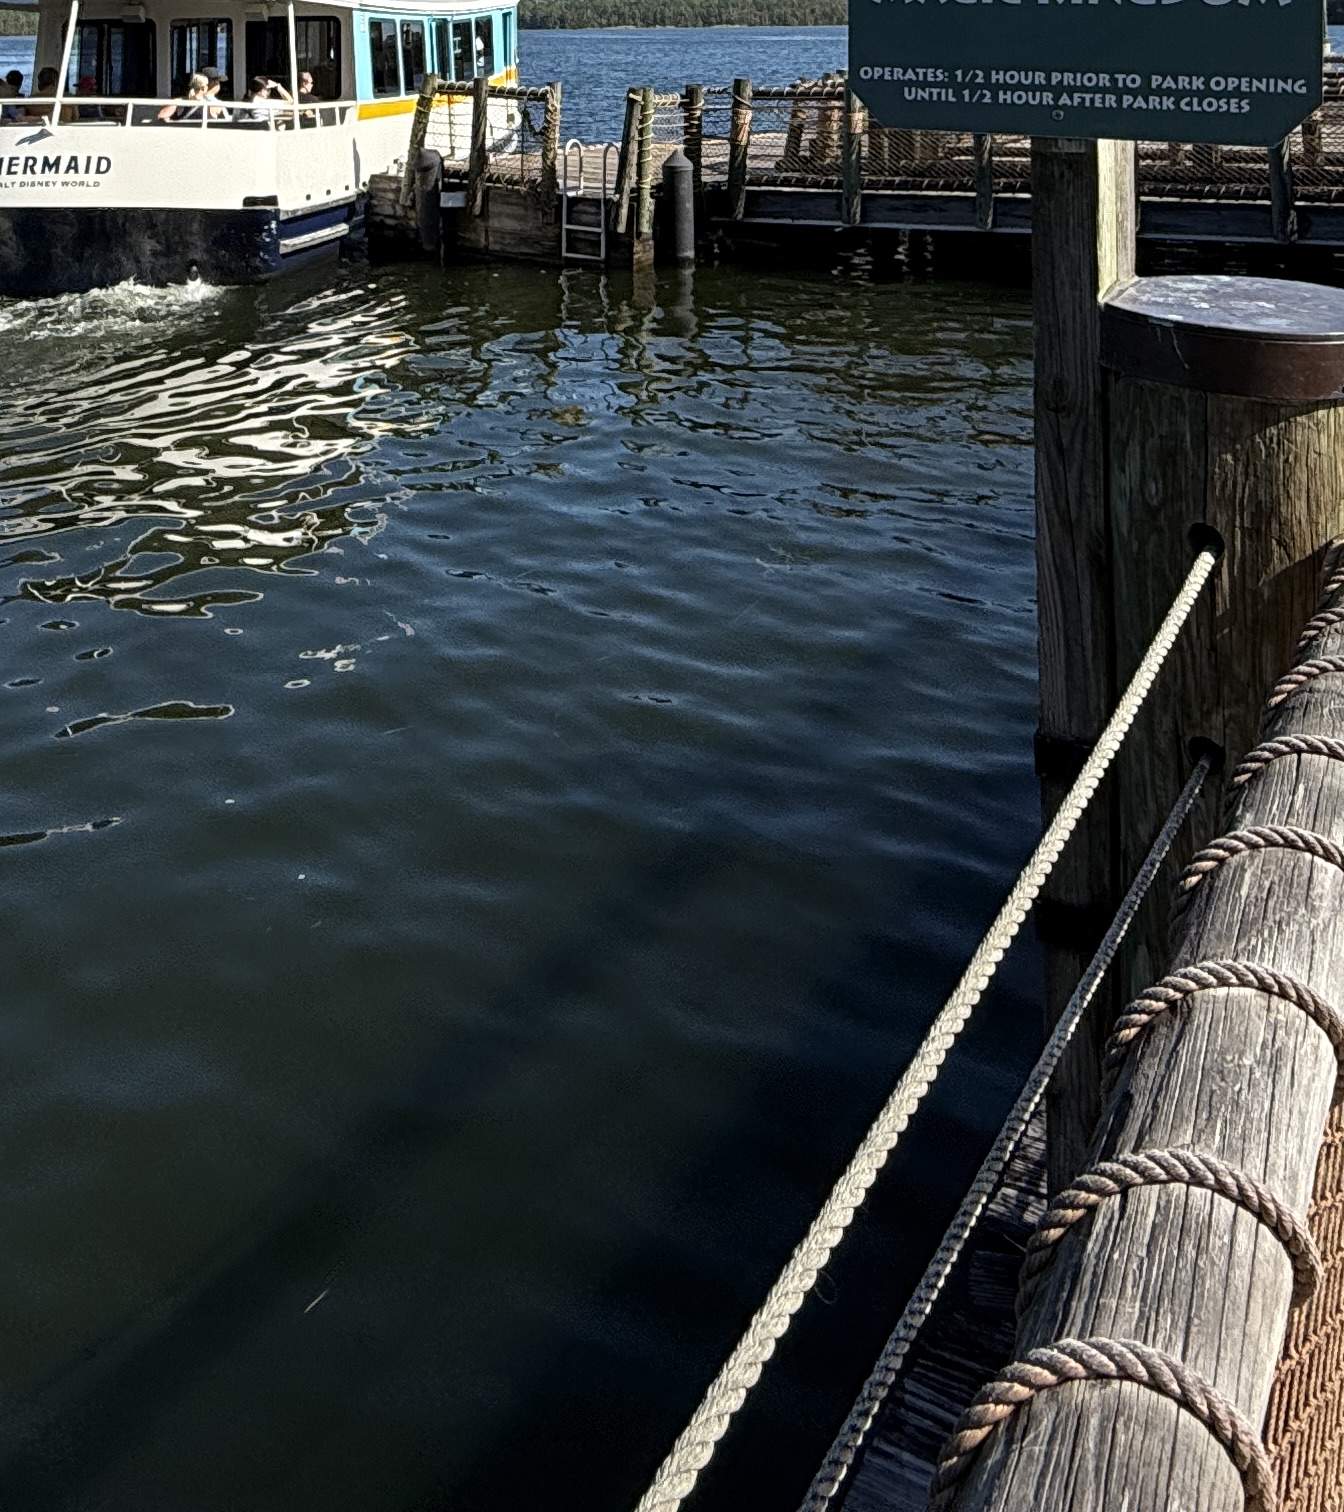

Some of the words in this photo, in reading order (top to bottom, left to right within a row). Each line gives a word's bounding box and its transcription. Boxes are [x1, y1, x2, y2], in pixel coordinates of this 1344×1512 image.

[860, 67, 948, 81] OPERATES:
[955, 70, 984, 83] 1/2
[992, 70, 1046, 84] HOUR
[1051, 72, 1110, 86] PRIOR
[1115, 74, 1141, 88] TO
[1152, 75, 1205, 90] PARK
[1210, 77, 1306, 93] OPENING
[904, 87, 956, 101] UNTIL
[963, 89, 991, 102] 1/2
[999, 91, 1054, 105] HOUR
[1058, 93, 1117, 107] AFTER
[1123, 95, 1175, 110] PARK
[1180, 97, 1250, 113] CLOSES
[19, 180, 57, 188] DISNEY
[61, 180, 100, 188] WORLD
